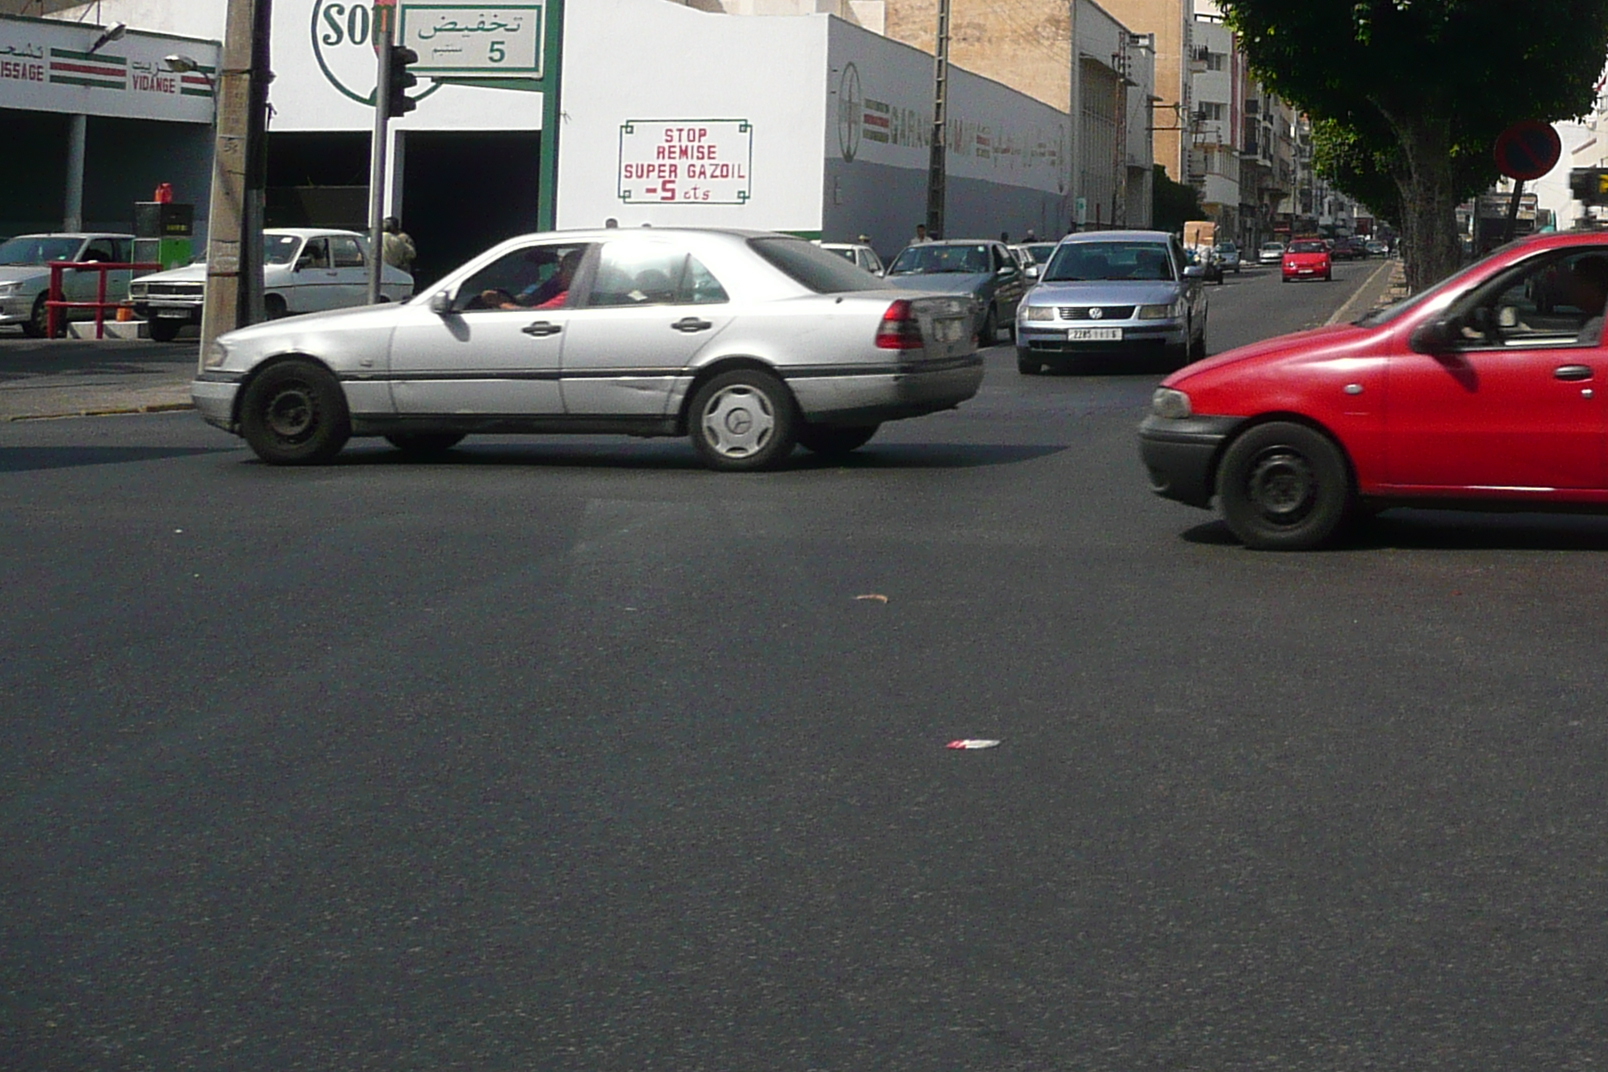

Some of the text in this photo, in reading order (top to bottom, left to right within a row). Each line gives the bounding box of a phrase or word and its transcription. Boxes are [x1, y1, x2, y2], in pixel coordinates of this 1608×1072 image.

[418, 13, 523, 39] تخفيض
[488, 41, 506, 63] 5
[132, 74, 176, 94] VIDANGE
[665, 128, 707, 143] STOP
[656, 145, 717, 160] REMISE
[624, 163, 746, 179] SUPER GAZOIL
[683, 184, 711, 201] cts
